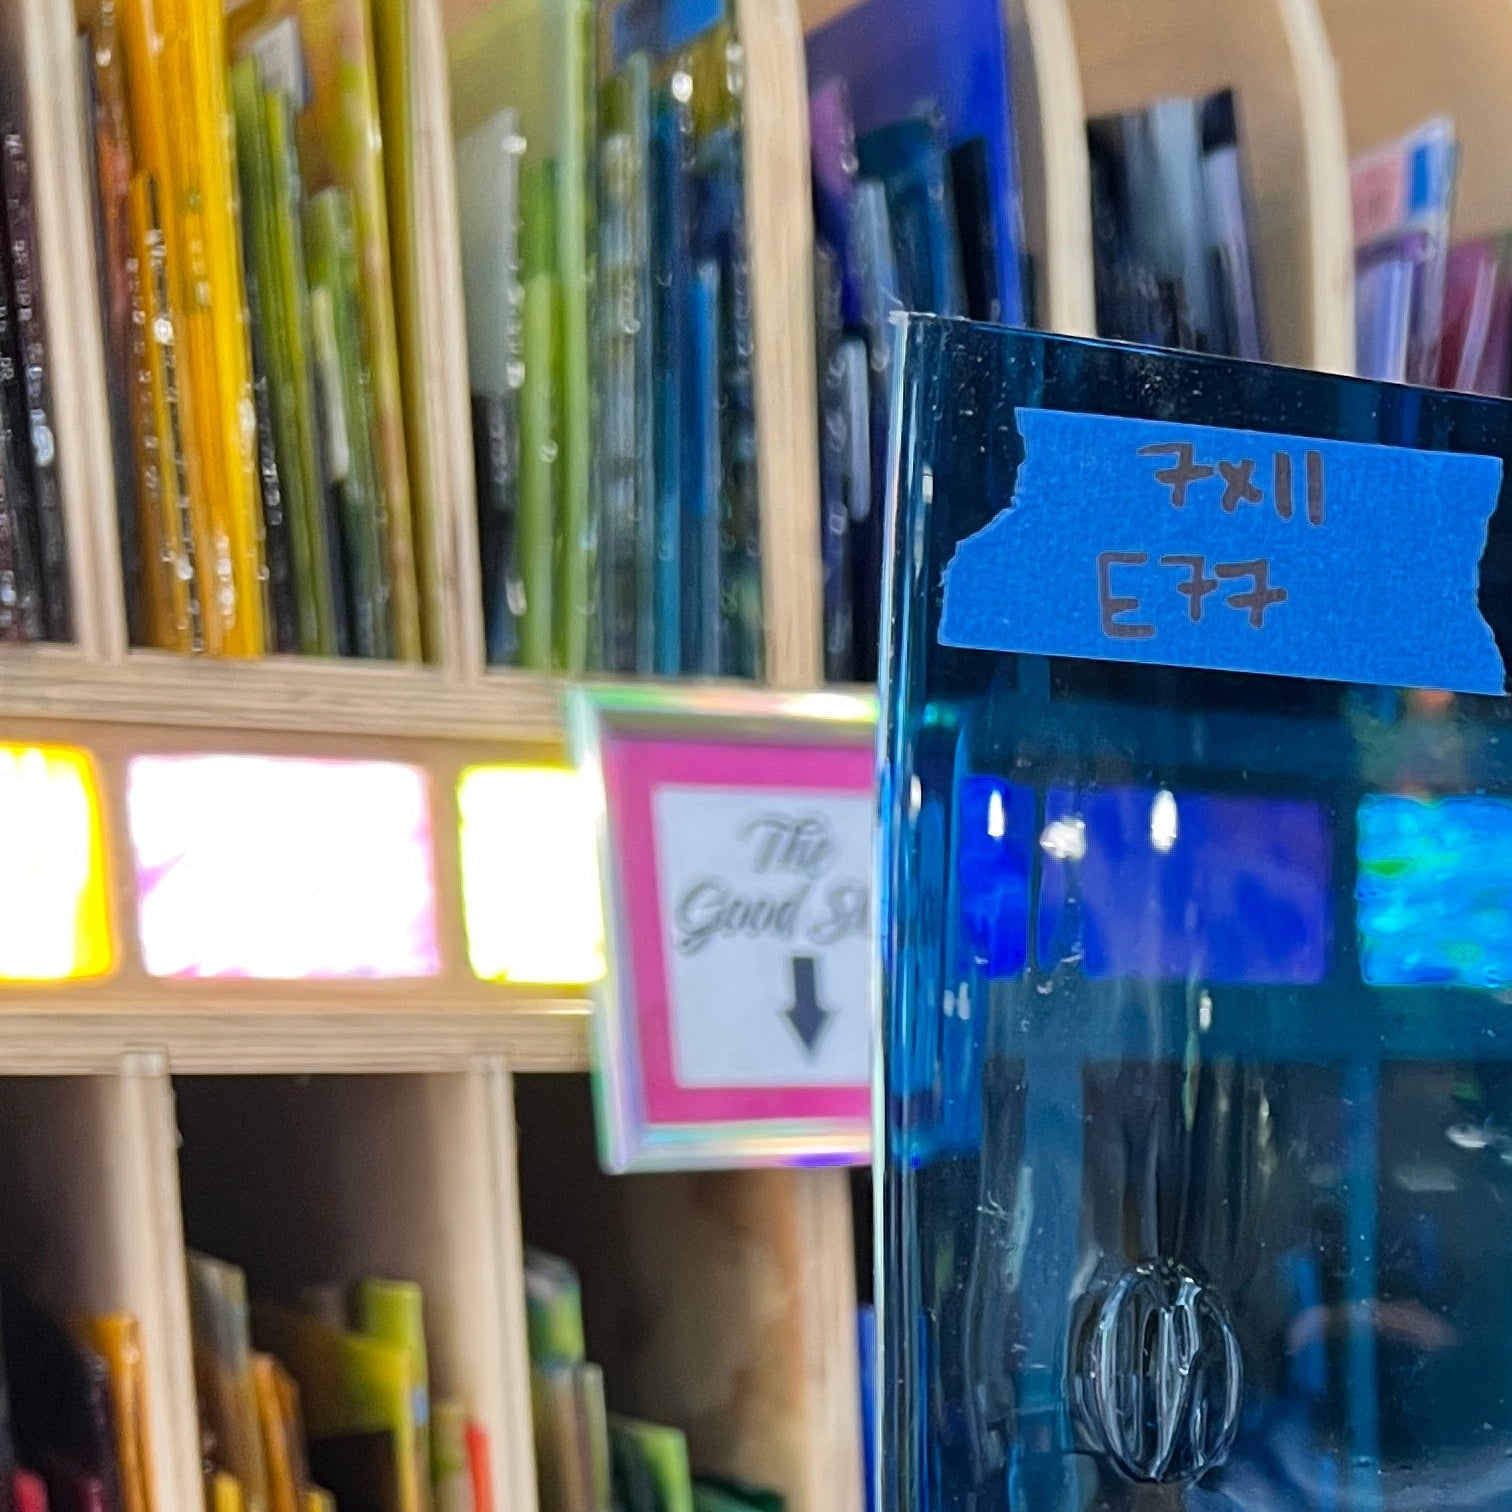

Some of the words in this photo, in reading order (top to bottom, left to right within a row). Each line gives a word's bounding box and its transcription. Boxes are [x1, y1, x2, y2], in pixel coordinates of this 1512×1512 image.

[1137, 442, 1323, 526] 7x11
[1098, 552, 1288, 638] E77
[738, 814, 830, 874] The
[677, 878, 811, 957] Good
